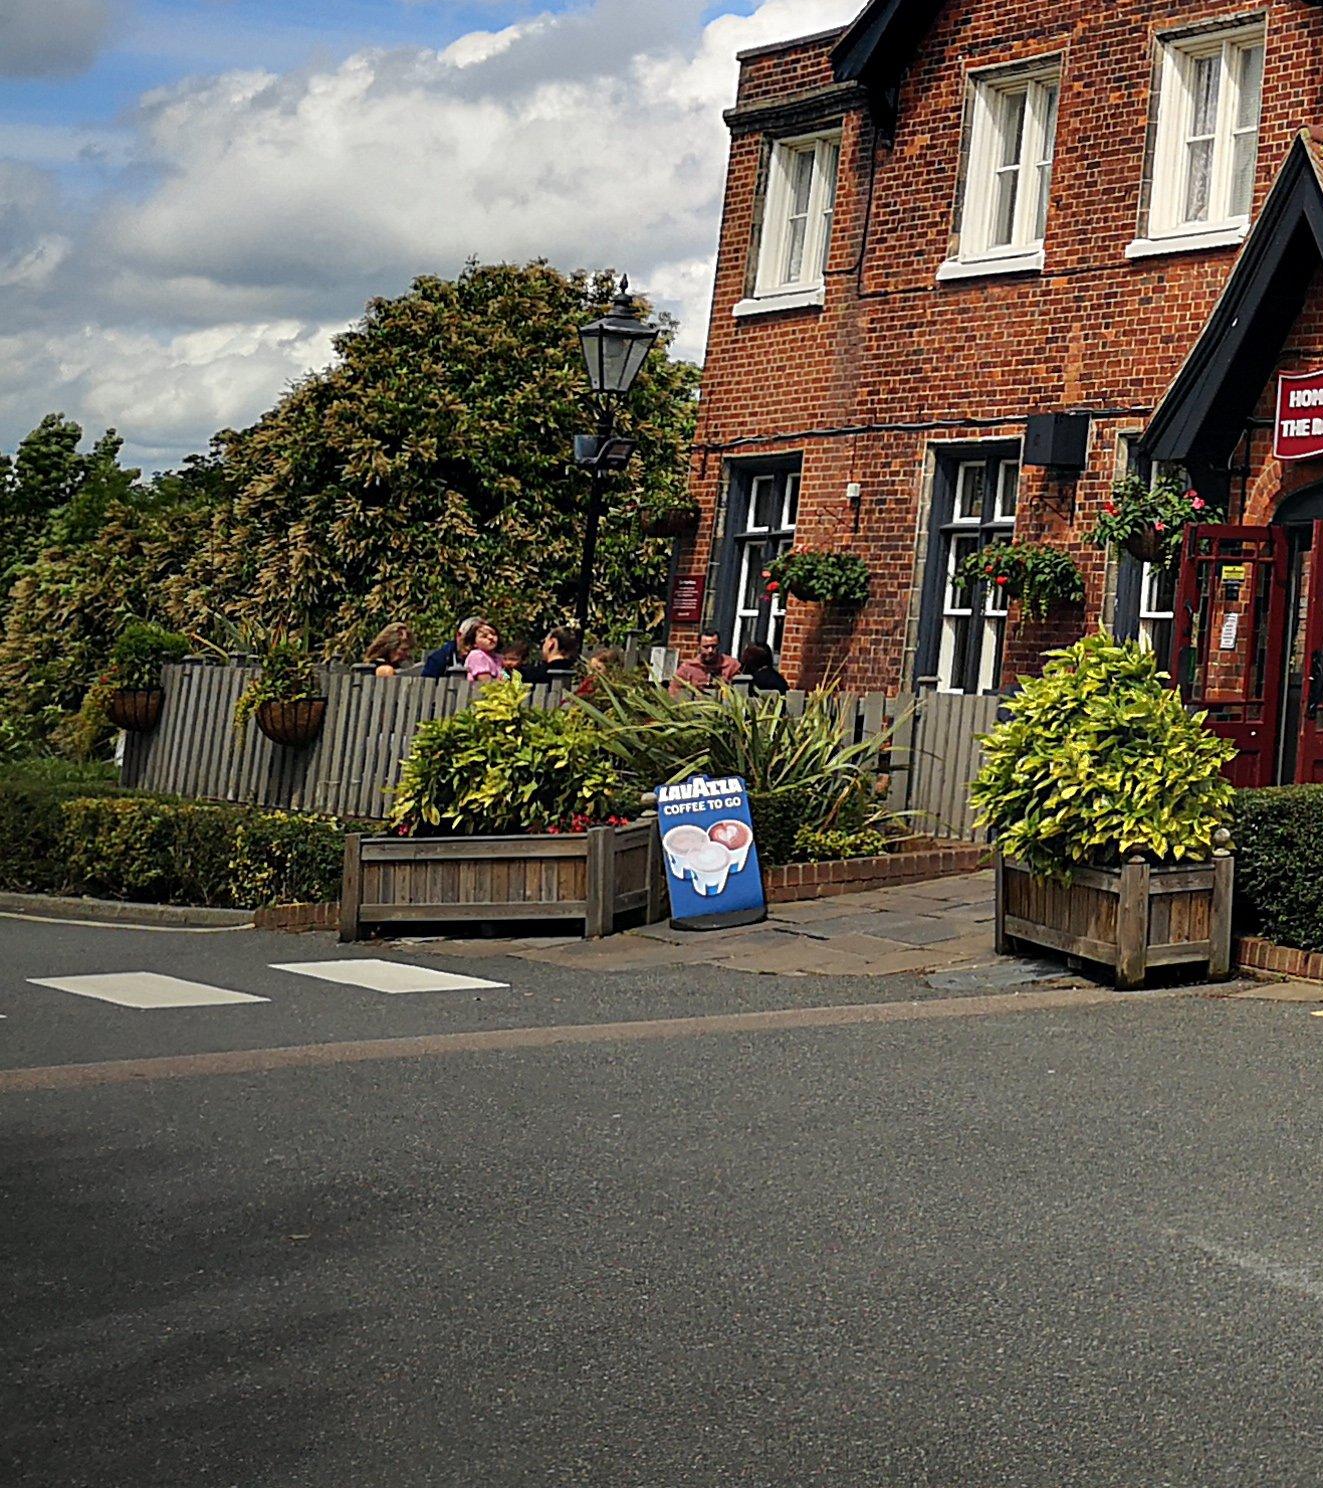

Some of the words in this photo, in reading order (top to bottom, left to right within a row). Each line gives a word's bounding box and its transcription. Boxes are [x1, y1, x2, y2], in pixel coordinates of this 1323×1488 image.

[1281, 419, 1311, 438] THE
[658, 777, 743, 802] LAVAZZA
[663, 800, 706, 815] COFFEE
[707, 799, 723, 810] TO
[724, 796, 742, 808] GO
